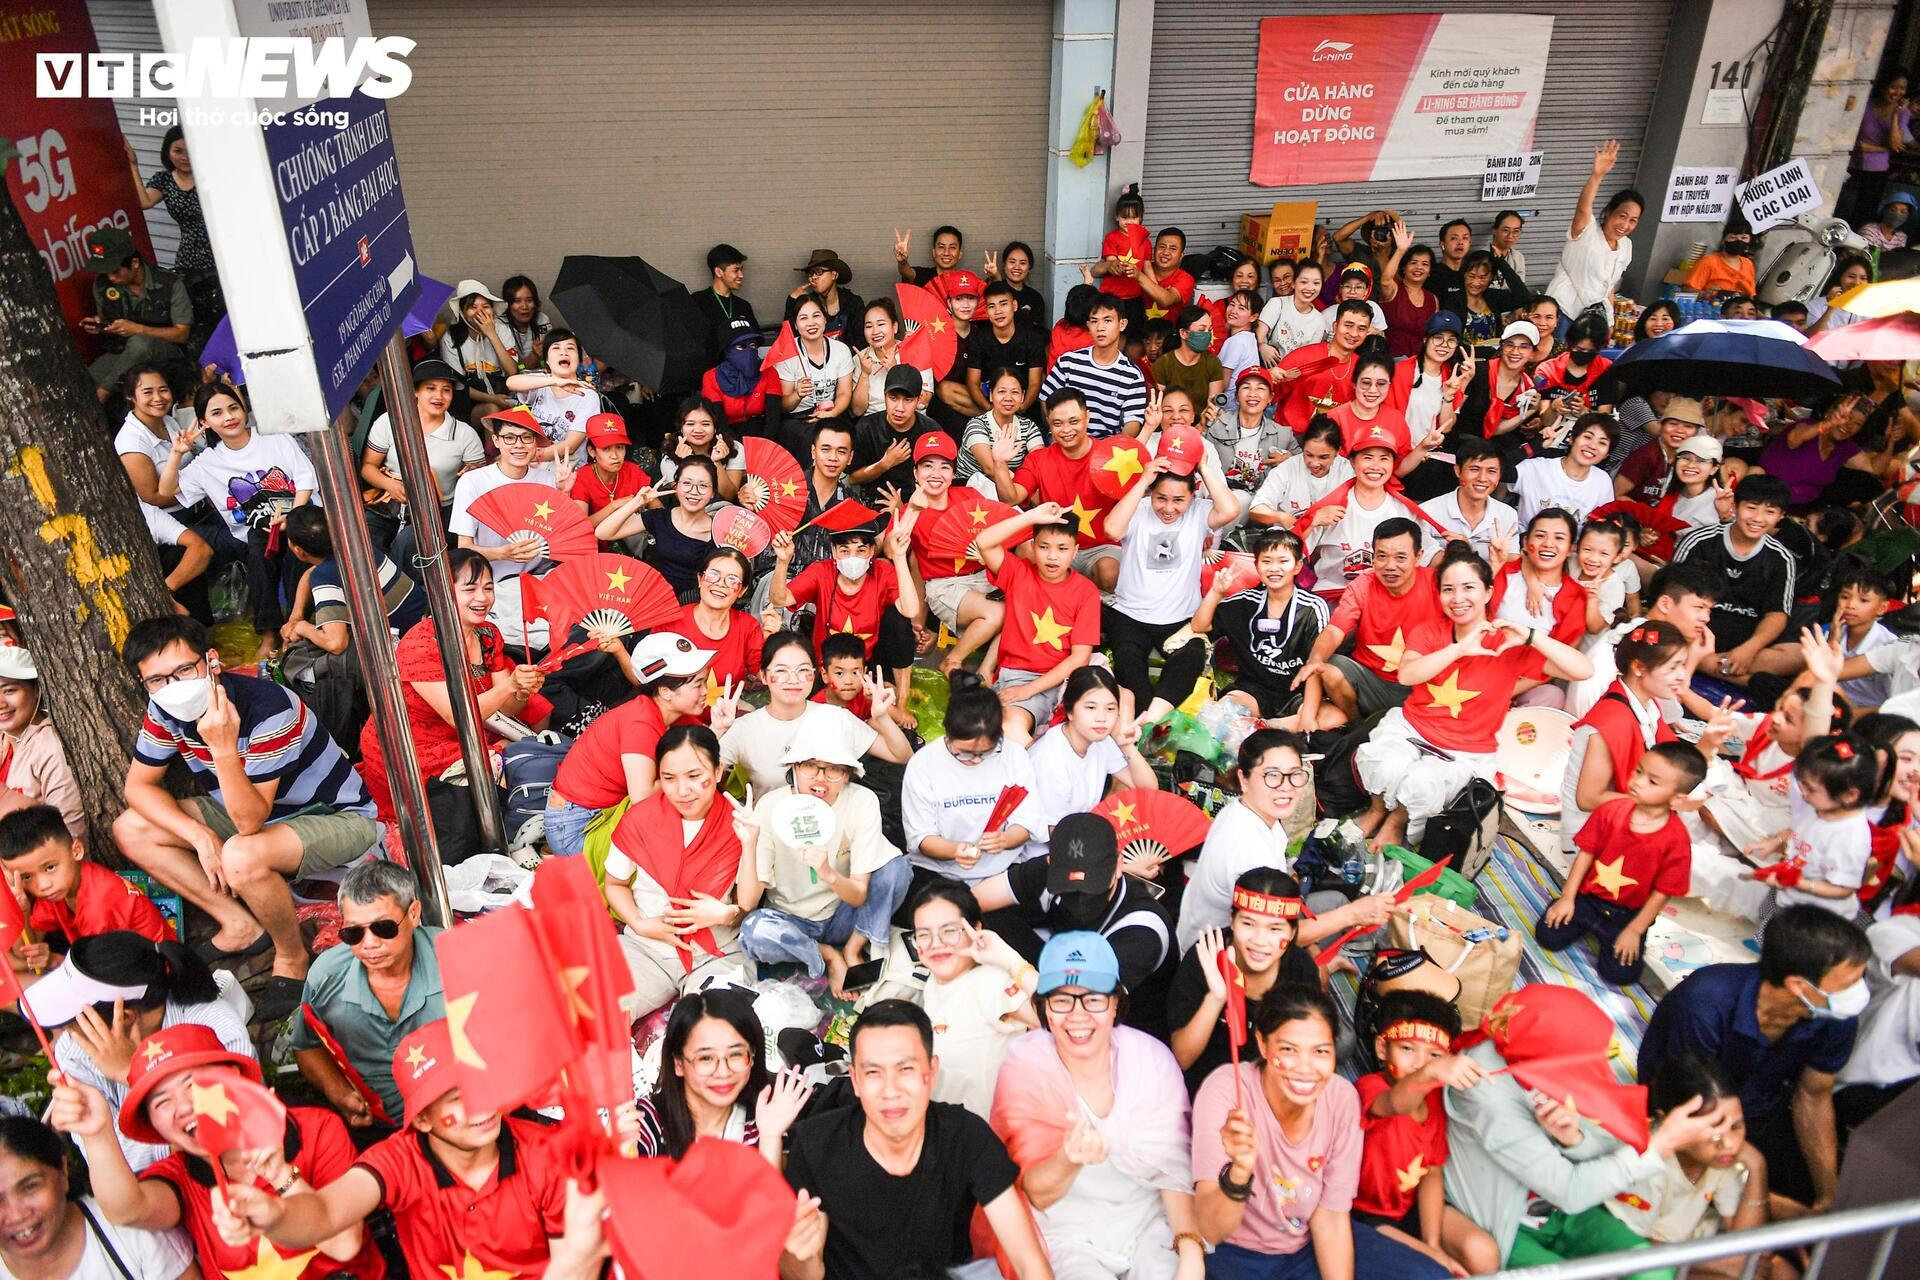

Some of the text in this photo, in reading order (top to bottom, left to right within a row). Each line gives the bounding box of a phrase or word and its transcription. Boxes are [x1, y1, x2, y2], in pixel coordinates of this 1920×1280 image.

[1311, 53, 1354, 62] LI-NING
[1430, 69, 1451, 78] Kính
[1473, 67, 1491, 78] quý
[1492, 66, 1520, 76] khách
[1481, 80, 1505, 89] hàng
[1283, 81, 1375, 102] CỬA HÀNG
[1423, 97, 1456, 110] LI-NING
[1301, 104, 1353, 122] DỪNG
[1451, 115, 1475, 124] tham
[1476, 115, 1500, 124] quan
[1273, 123, 1376, 147] HOẠT ĐỘNG
[1444, 127, 1465, 136] mua
[277, 138, 338, 204] CHƯƠNG
[333, 113, 369, 169] TRÌNH
[1507, 156, 1523, 168] BAO
[16, 128, 78, 213] 5G
[1485, 172, 1498, 183] GIA
[1694, 175, 1709, 186] BAO
[1715, 174, 1730, 185] 20K
[1773, 165, 1804, 190] LẠNH
[1672, 190, 1684, 201] GIA
[1710, 203, 1724, 214] 20K
[1752, 185, 1812, 222] CÁC LOẠI
[291, 156, 399, 267] CẤP 2 BẰNG ĐẠI HỌC
[943, 794, 998, 809] BURBERR
